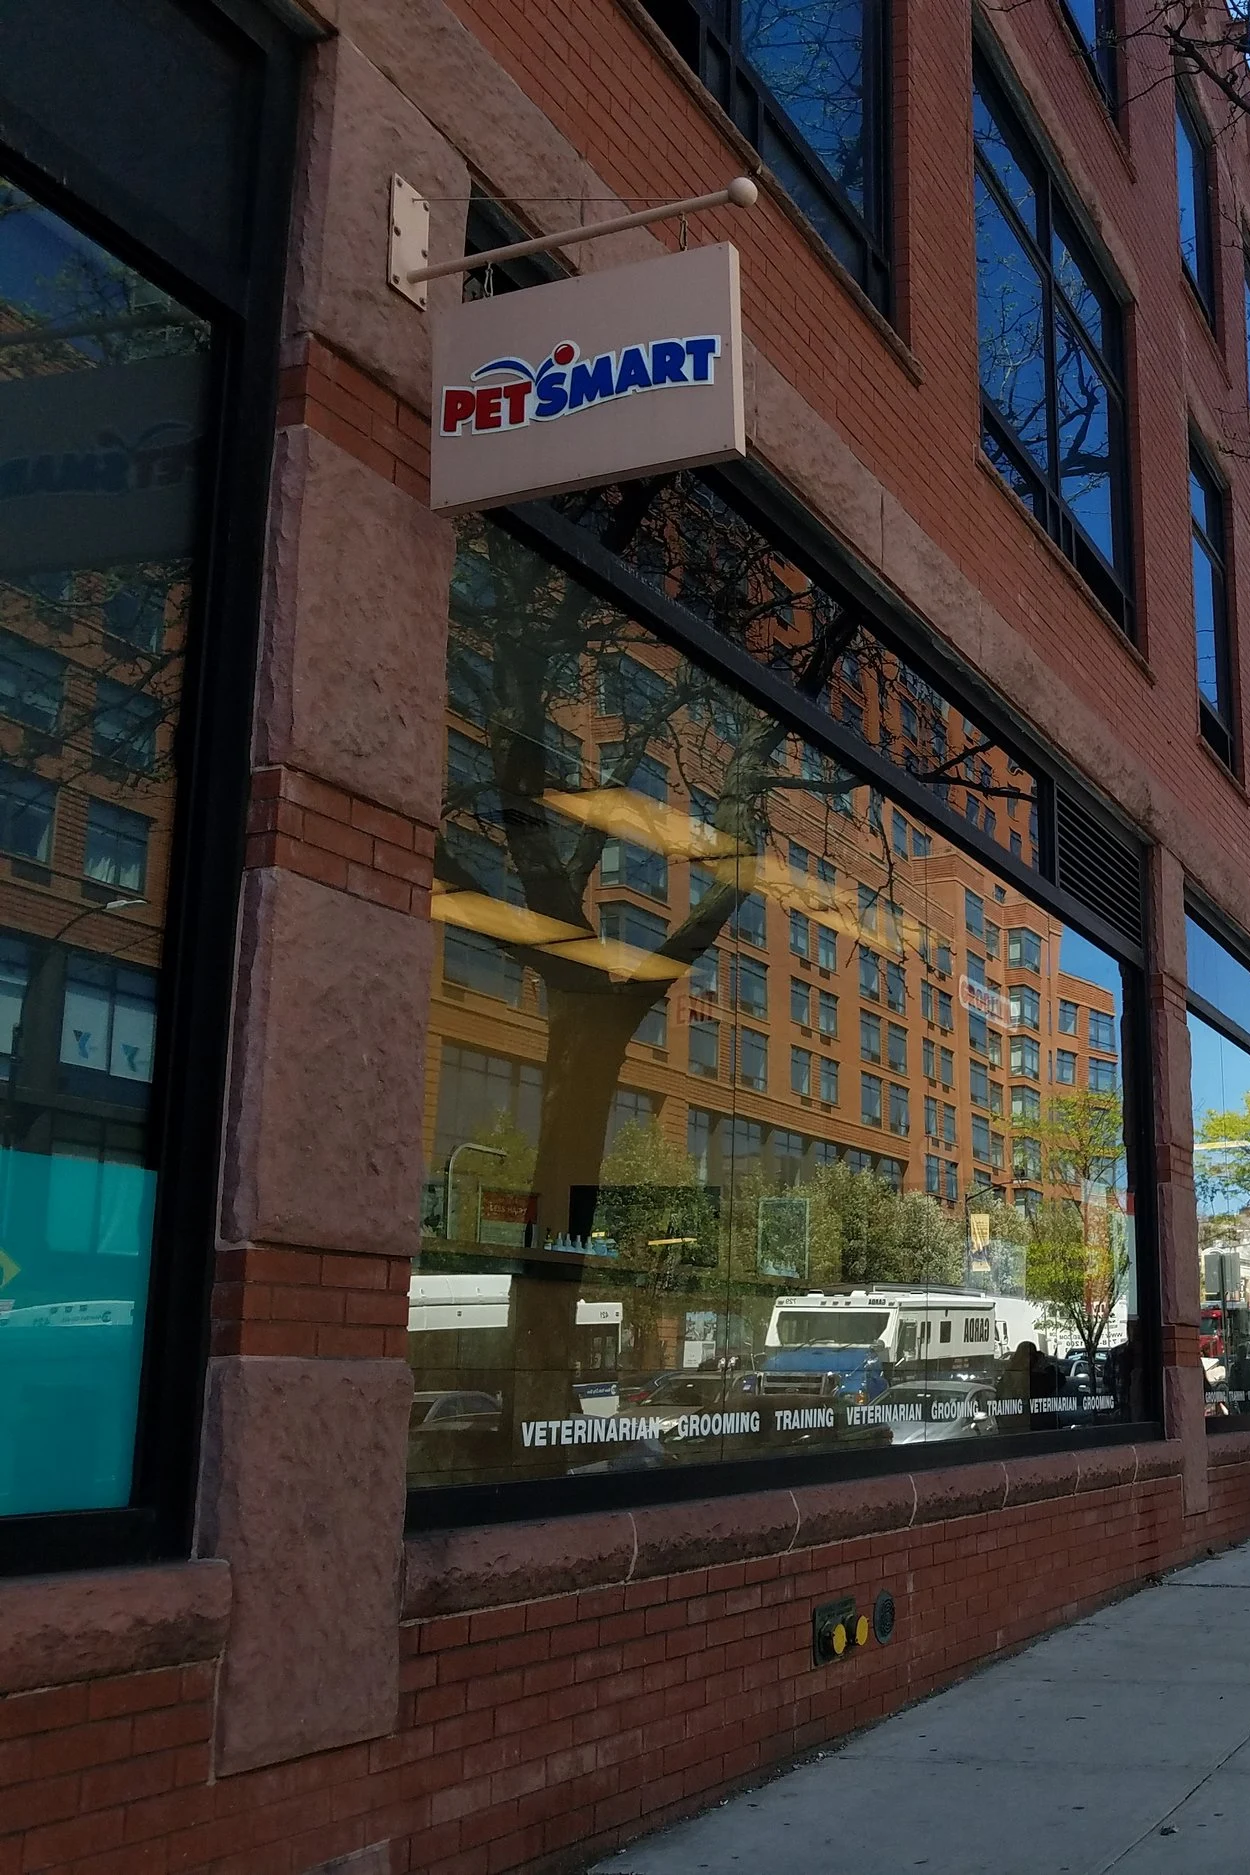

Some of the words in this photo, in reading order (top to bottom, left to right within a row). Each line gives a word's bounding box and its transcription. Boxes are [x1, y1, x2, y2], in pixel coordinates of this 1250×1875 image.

[442, 338, 716, 433] PETSMART
[522, 1416, 660, 1447] VETERINARIAN
[678, 1411, 760, 1438] GROOMING
[775, 1407, 834, 1431] TRAINING
[846, 1403, 922, 1426] VETERINARIAN
[931, 1400, 979, 1420] GROOMING
[987, 1399, 1023, 1416] TRAINING
[1029, 1396, 1078, 1414] VETERINARIAN
[1082, 1395, 1115, 1410] GROOMING
